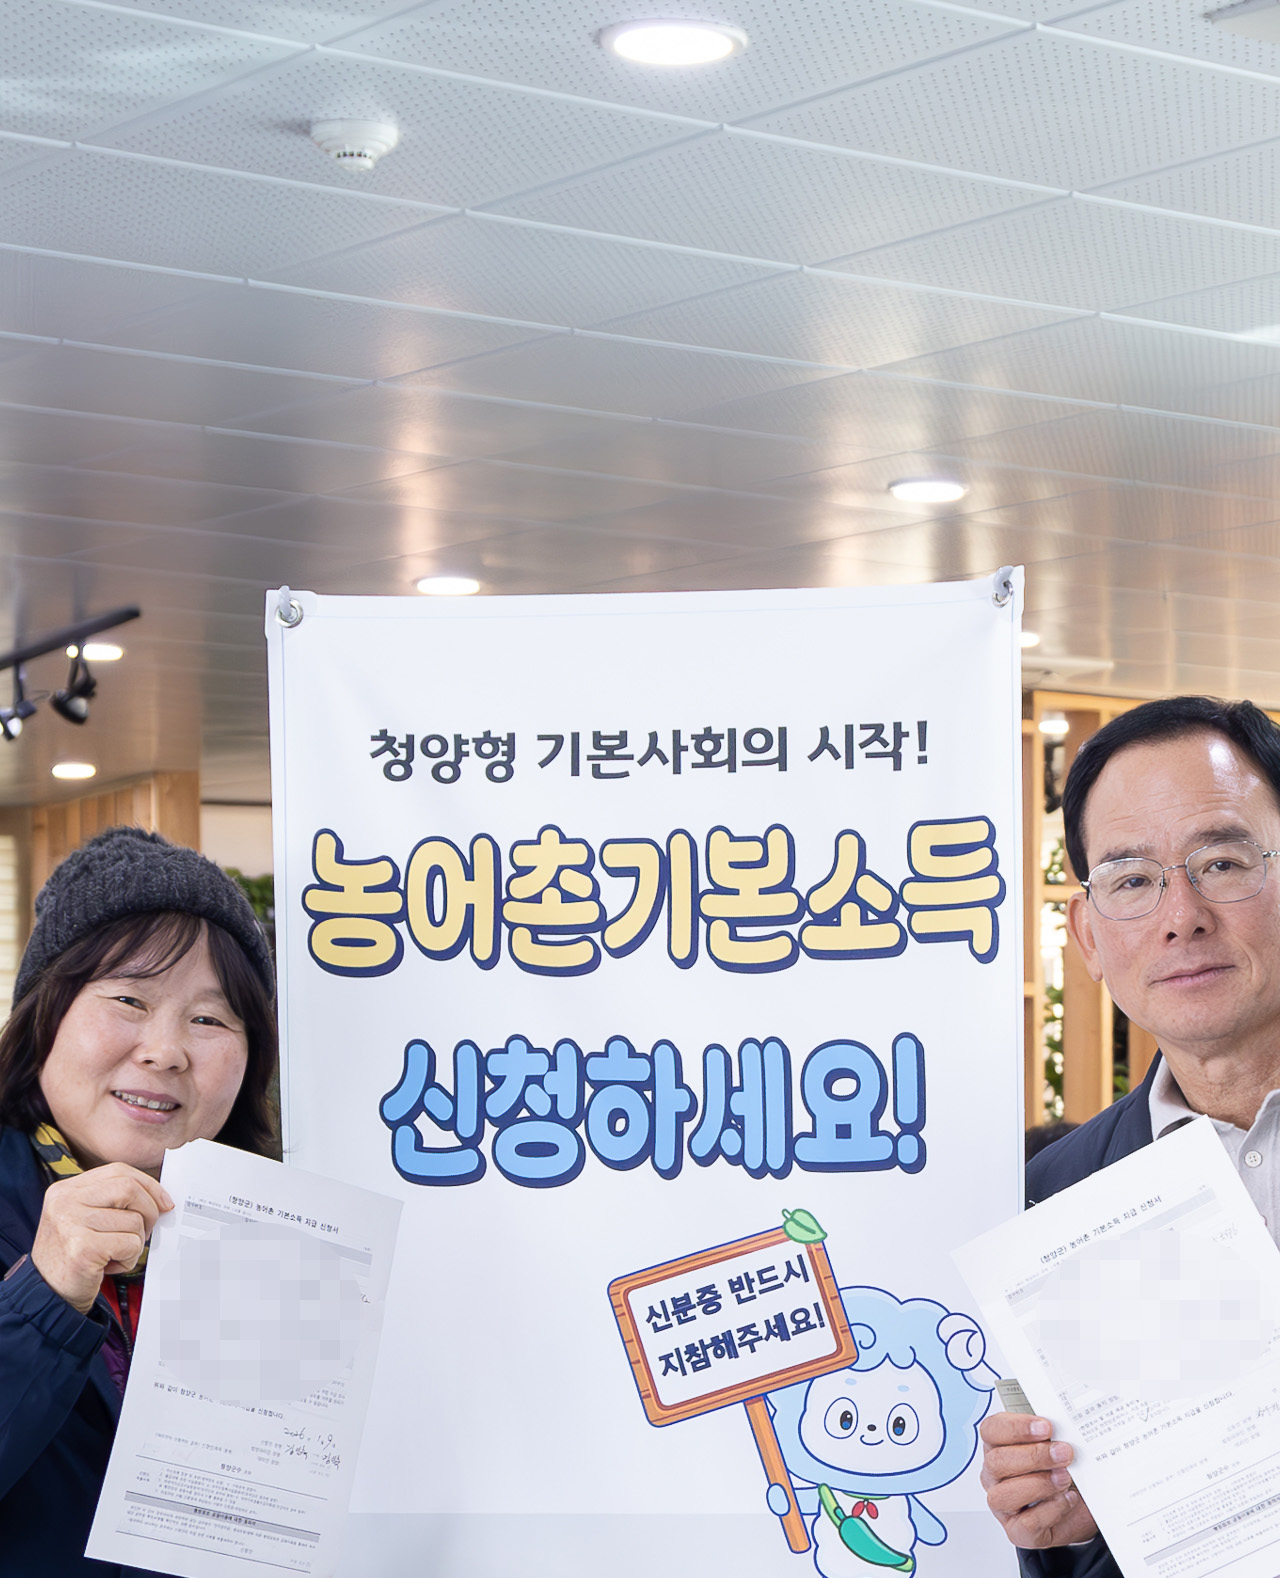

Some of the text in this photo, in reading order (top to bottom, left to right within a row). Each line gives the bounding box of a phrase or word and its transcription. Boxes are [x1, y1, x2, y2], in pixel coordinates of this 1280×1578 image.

[370, 721, 927, 784] 청양형 기본사회의 시작!
[301, 816, 1006, 977] 농어촌기본소득
[379, 1033, 927, 1186] 신청하세요!
[645, 1254, 810, 1333] 신분증 반드시
[658, 1302, 825, 1377] 지참해주세요!
